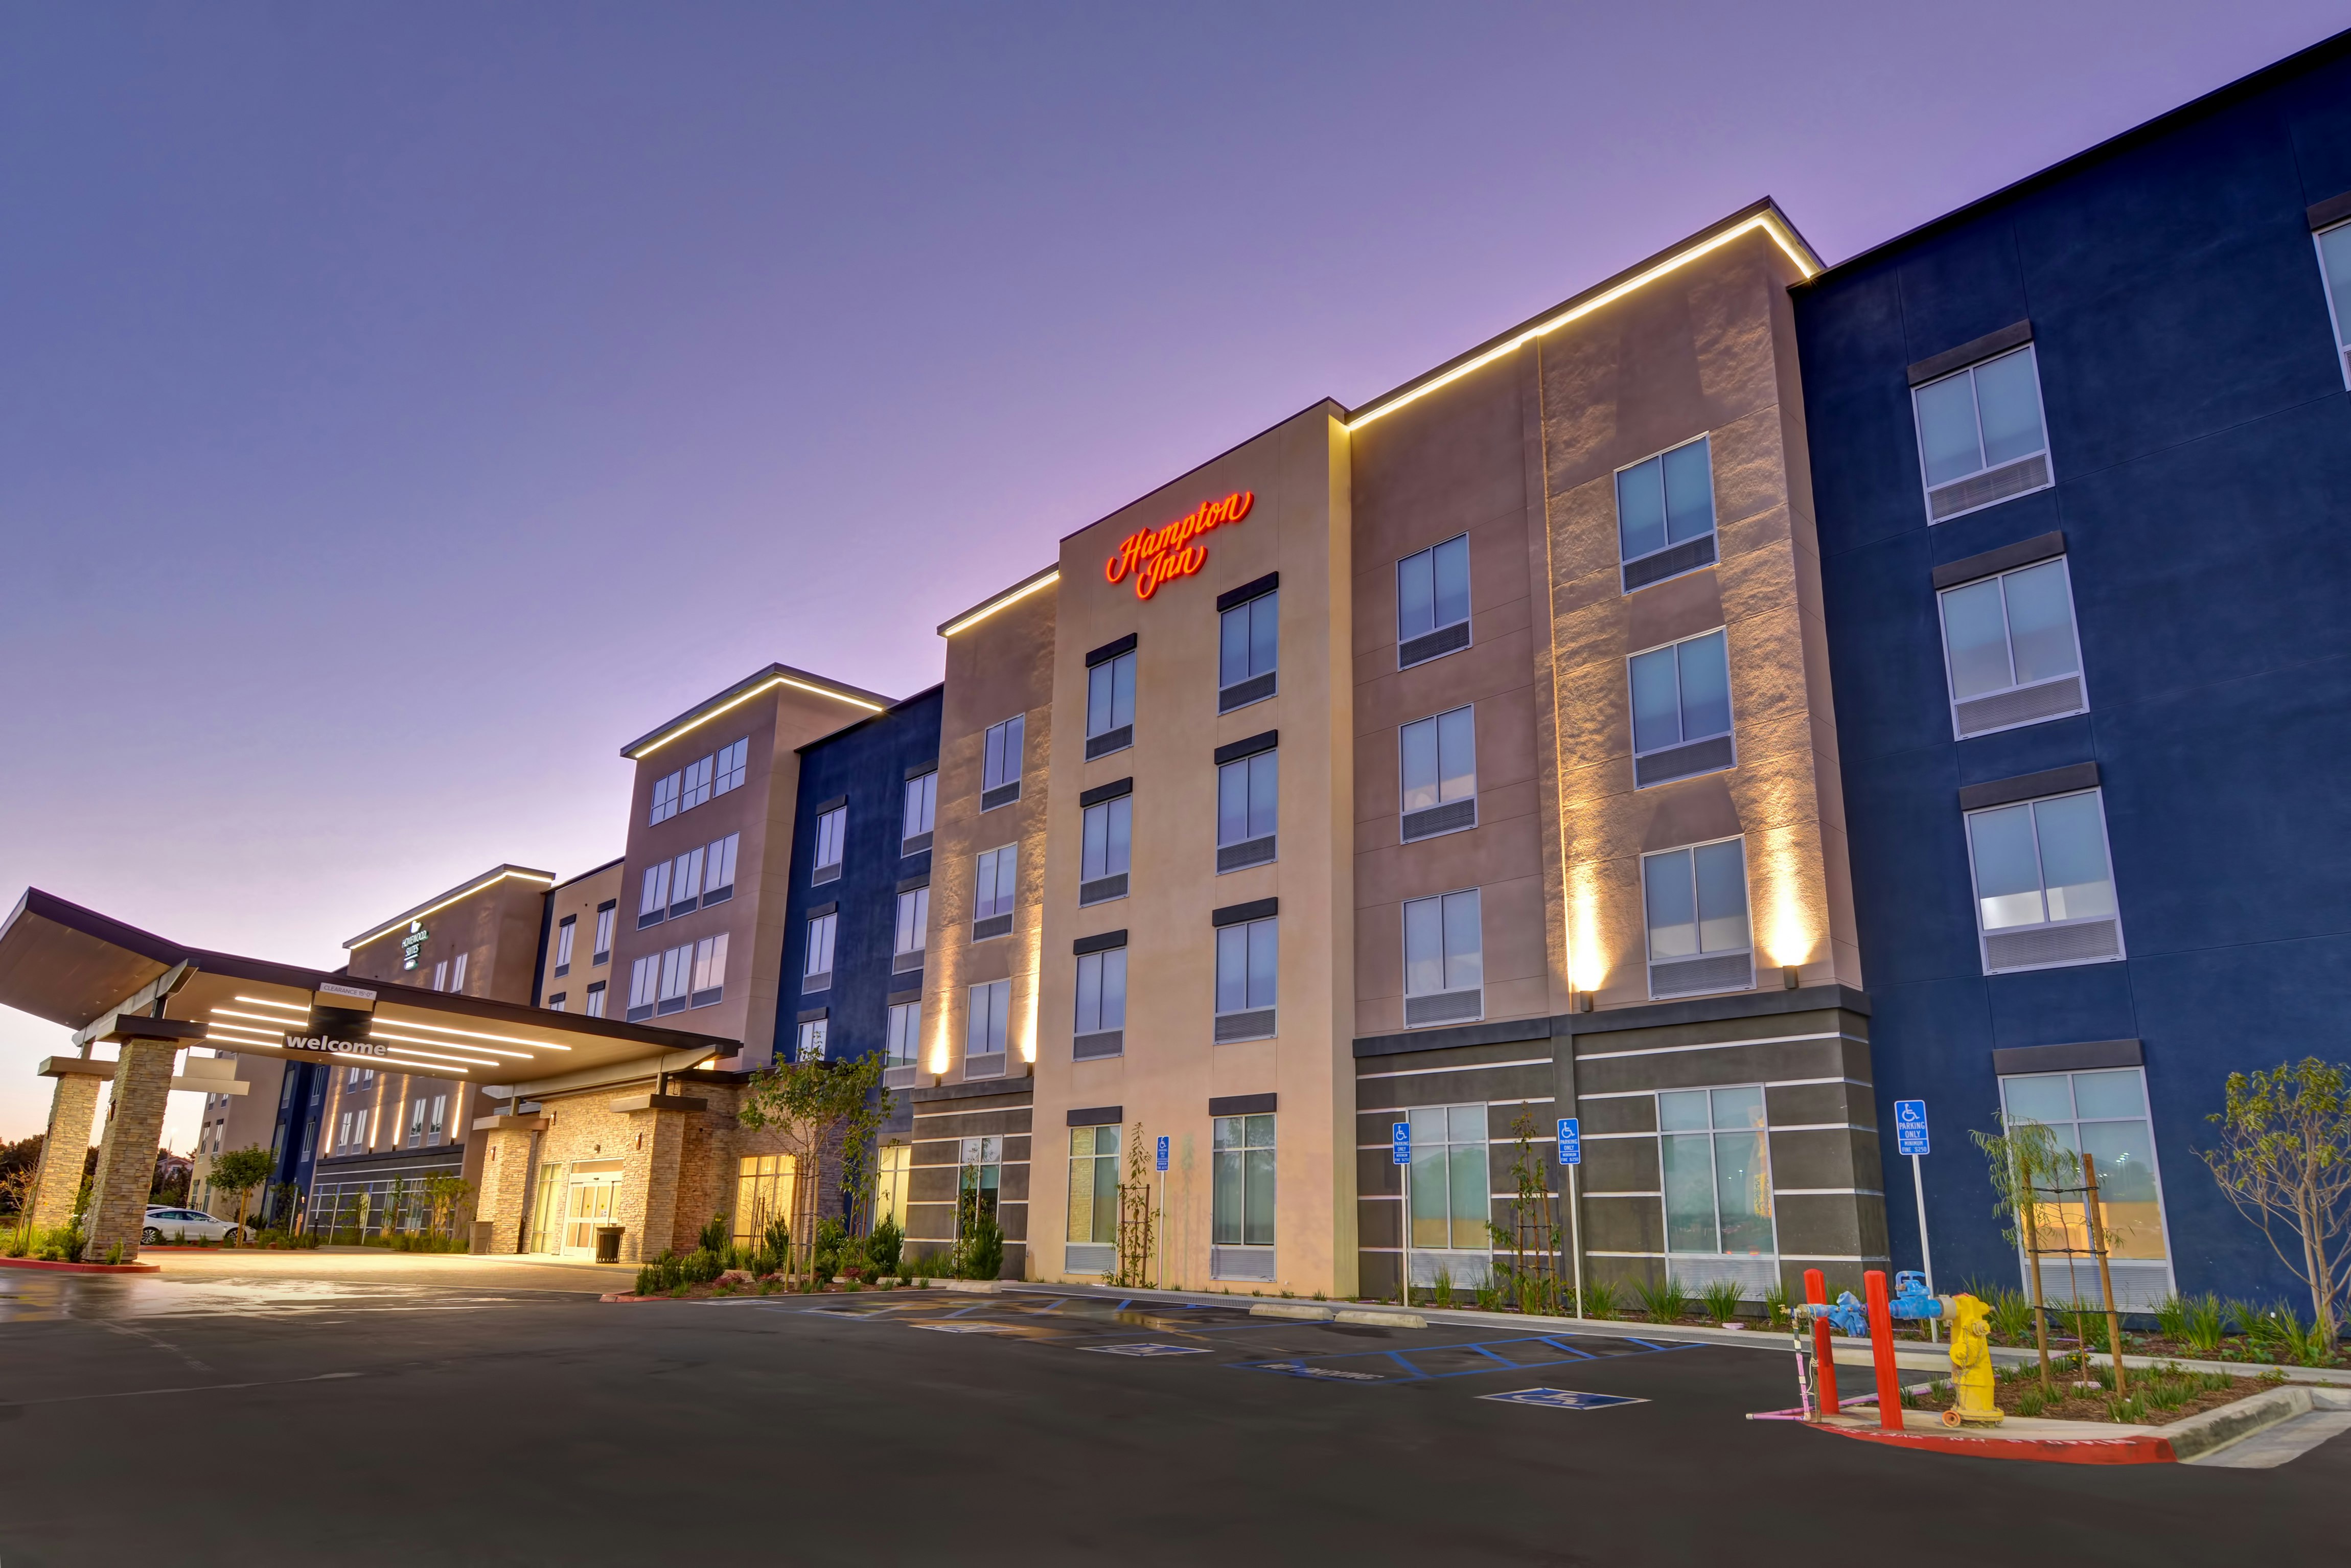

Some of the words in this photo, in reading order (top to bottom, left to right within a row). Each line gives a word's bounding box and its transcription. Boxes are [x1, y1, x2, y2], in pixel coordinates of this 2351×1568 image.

[1106, 492, 1254, 584] Hampton
[1137, 545, 1208, 600] Inn
[401, 930, 427, 948] HOMEWOOD
[324, 985, 358, 995] CLEARANCE
[286, 1035, 386, 1056] welcome
[1899, 1121, 1925, 1130] PARKING
[1904, 1130, 1921, 1139] ONLY
[1288, 1367, 1385, 1380] PARKING
